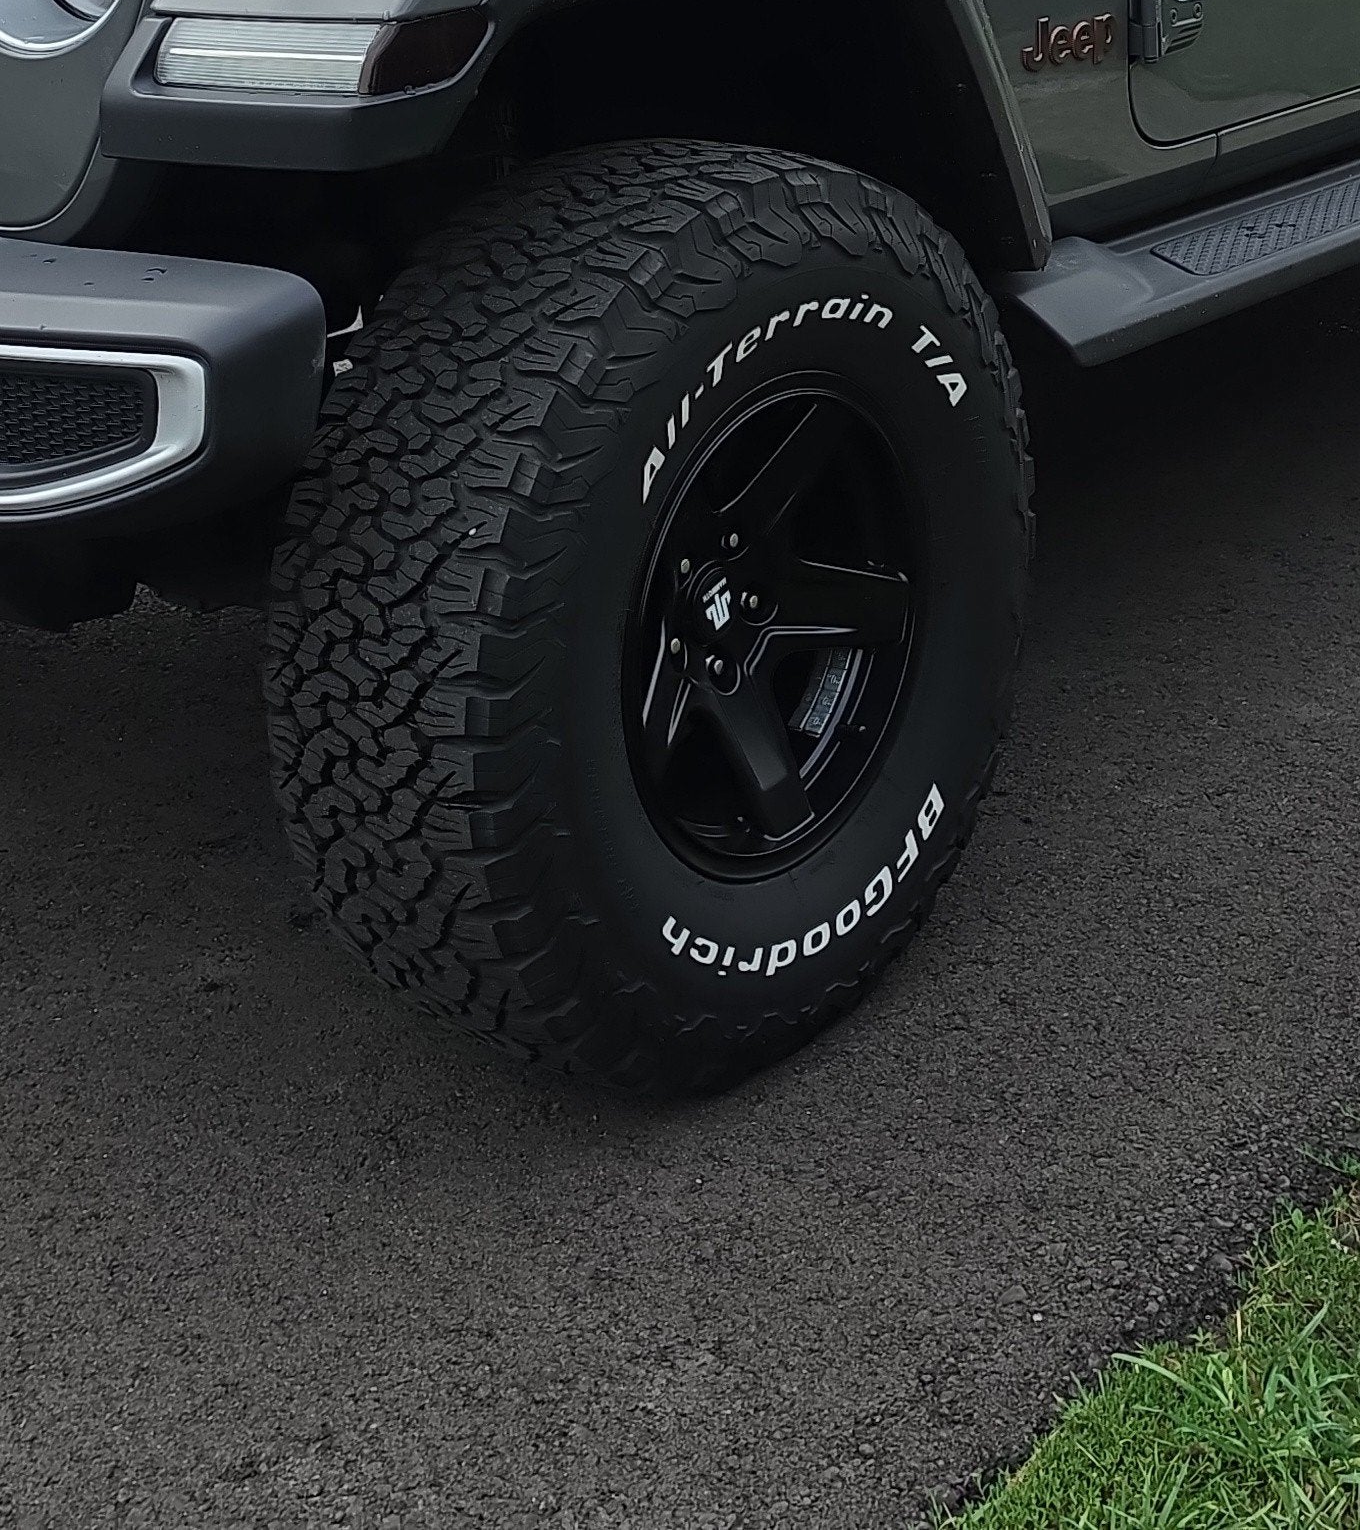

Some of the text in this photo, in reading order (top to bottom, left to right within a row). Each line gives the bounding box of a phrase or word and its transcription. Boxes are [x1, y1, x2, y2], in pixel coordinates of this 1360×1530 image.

[1021, 13, 1117, 72] Jeep
[642, 293, 894, 506] All-Terrain
[661, 782, 945, 977] BFGoodrich
